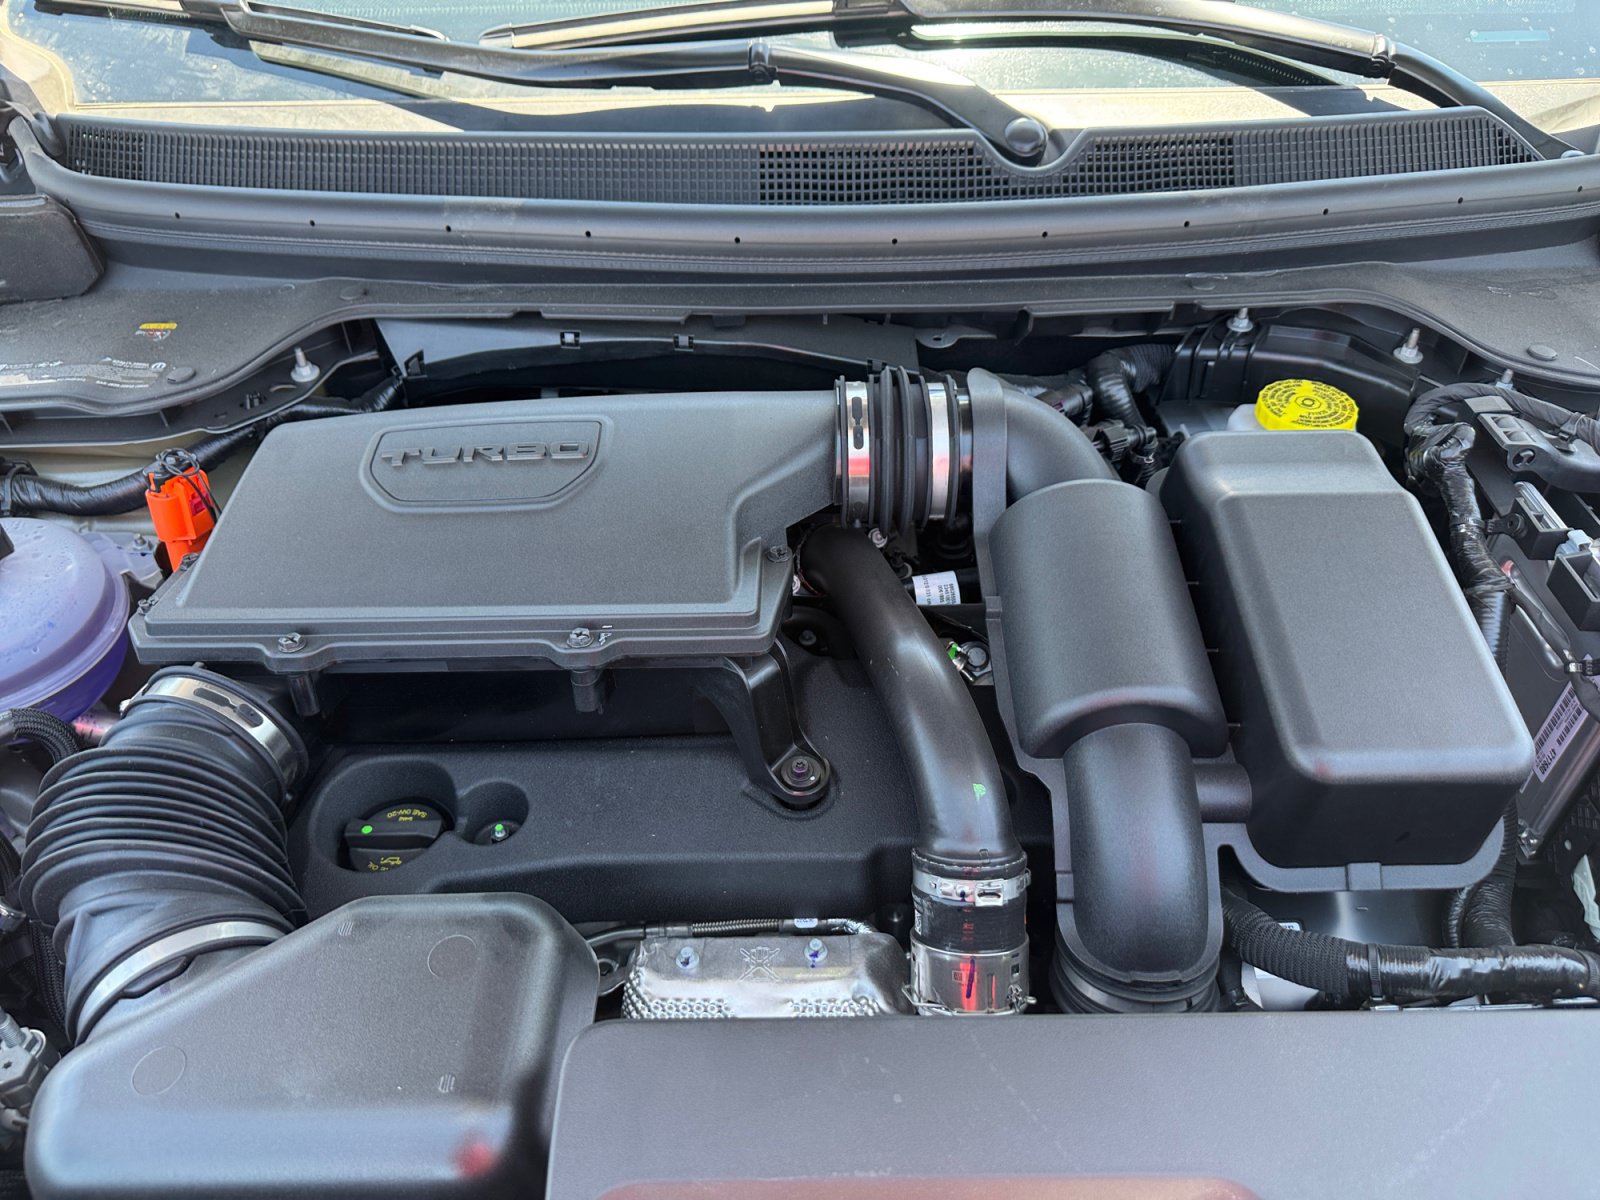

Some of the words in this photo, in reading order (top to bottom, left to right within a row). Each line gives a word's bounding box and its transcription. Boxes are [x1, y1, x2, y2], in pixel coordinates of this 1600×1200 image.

[381, 441, 590, 467] TURBO
[387, 809, 411, 818] 0W-20
[412, 809, 428, 818] SAE
